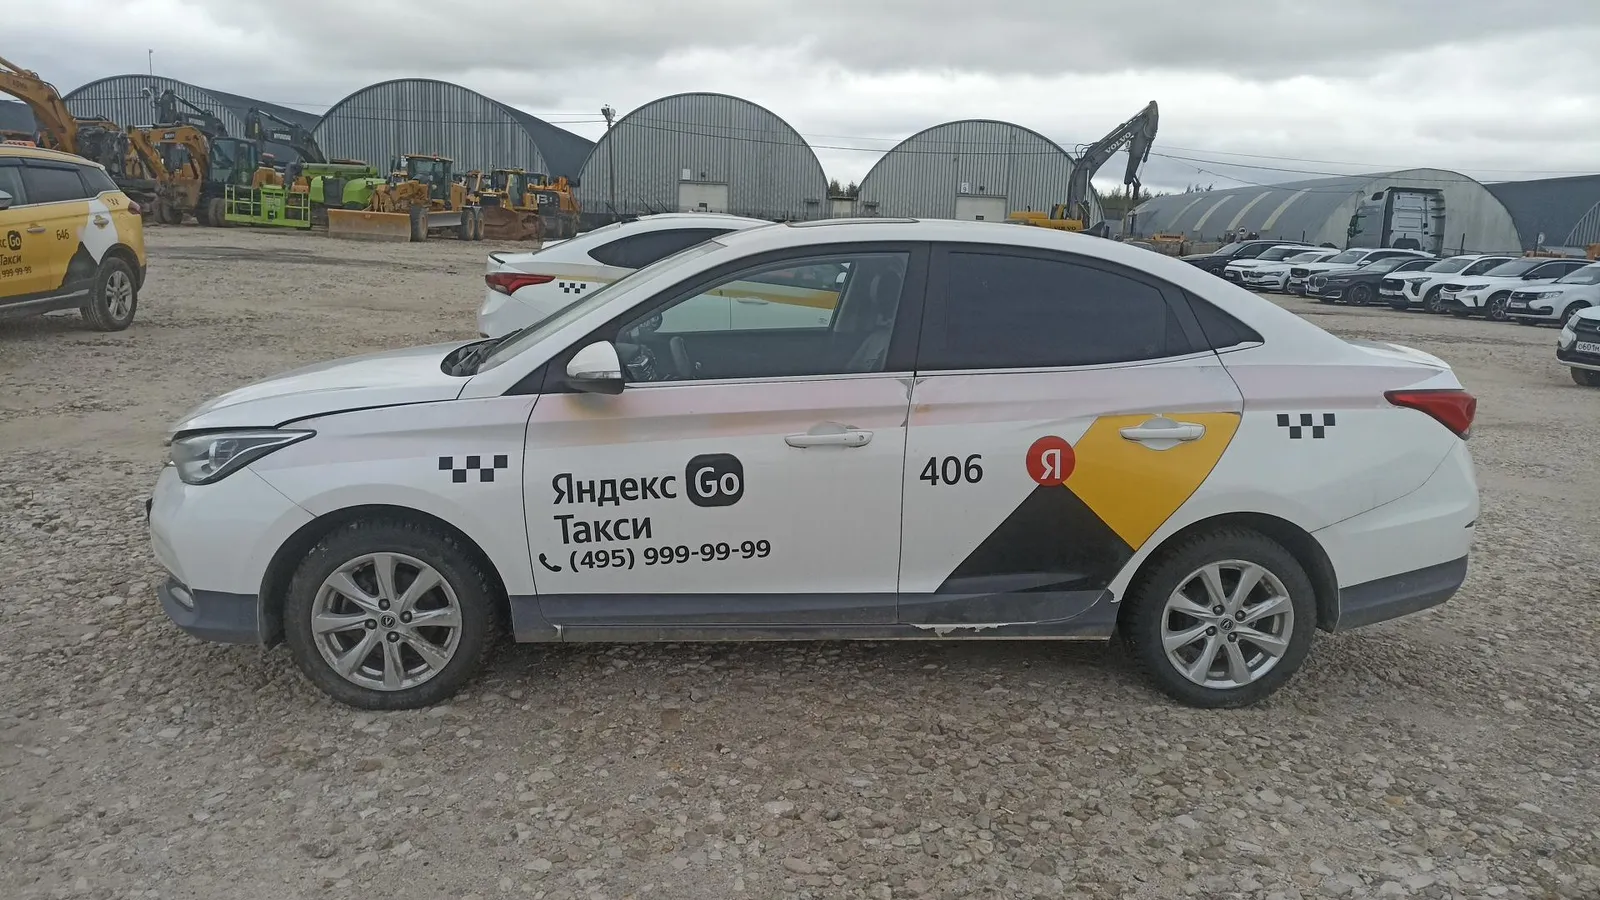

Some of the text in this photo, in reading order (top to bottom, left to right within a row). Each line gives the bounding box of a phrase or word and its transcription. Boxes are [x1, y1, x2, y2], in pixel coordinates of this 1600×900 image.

[1105, 132, 1131, 154] VOLVO
[56, 230, 69, 240] 646
[919, 453, 984, 486] 406
[1040, 448, 1061, 480] Я
[552, 466, 740, 507] Яндекс Go
[553, 514, 653, 545] Такси
[569, 539, 772, 573] (495) 999-99-99
